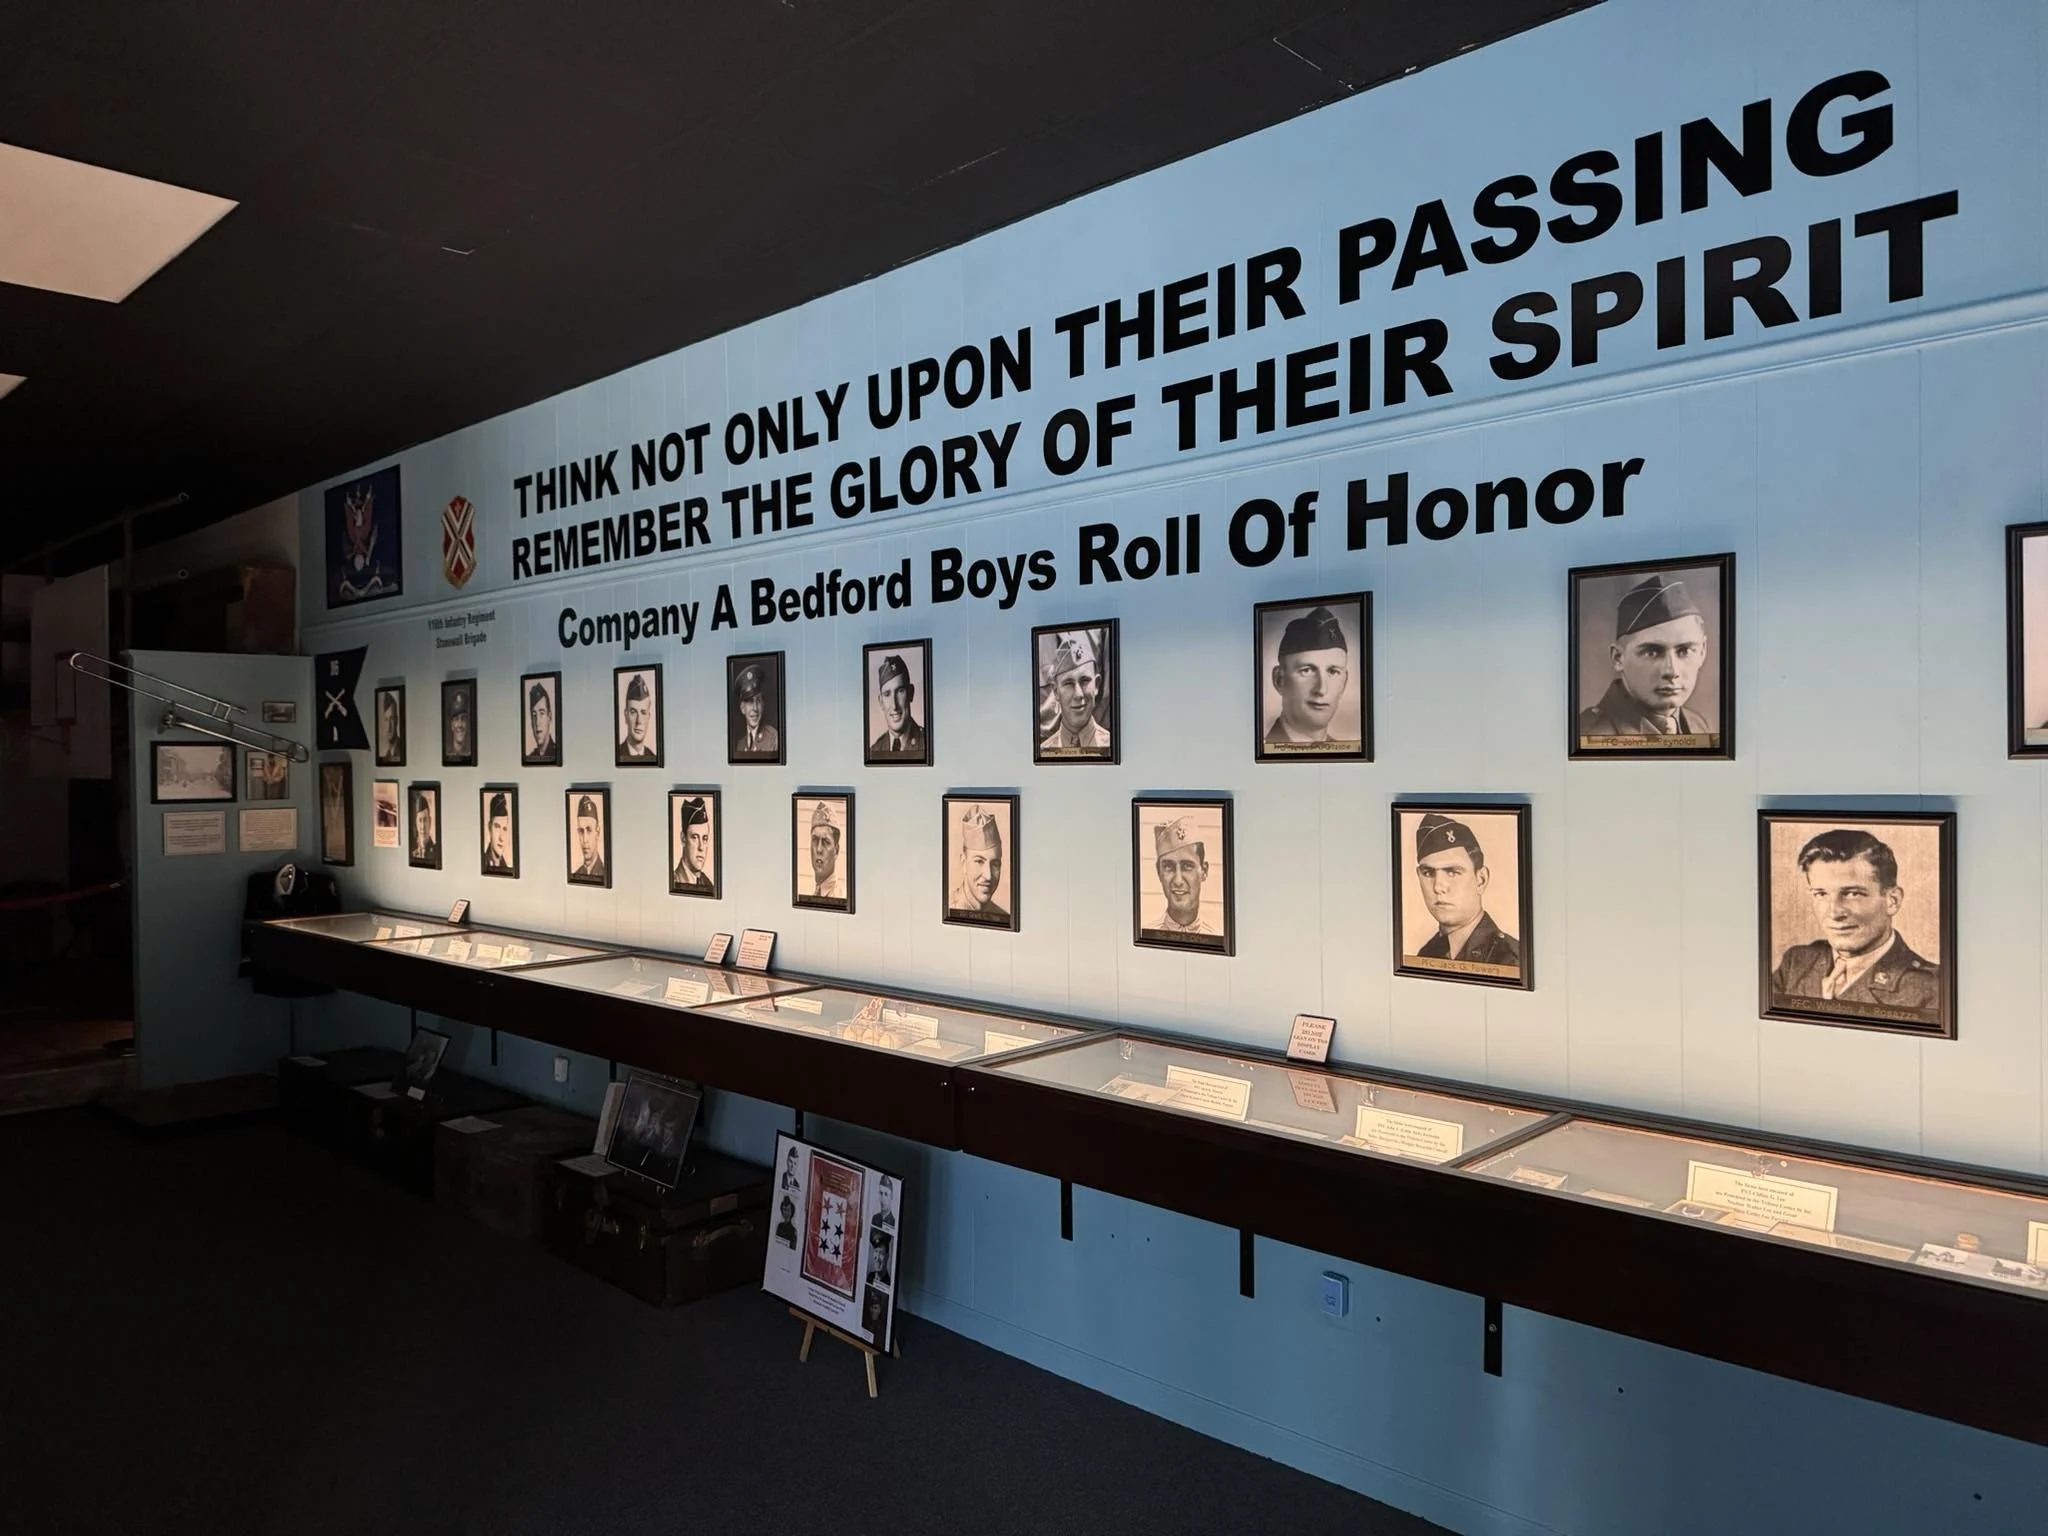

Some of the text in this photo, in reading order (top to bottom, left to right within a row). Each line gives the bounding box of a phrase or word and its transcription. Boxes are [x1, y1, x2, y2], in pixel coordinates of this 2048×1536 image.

[513, 71, 1894, 519] THINK NOT ONLY UPON THEIR PASSING
[513, 190, 1959, 581] REMEMBER THE GLORY OF THEIR SPIRIT
[444, 615, 466, 629] Infantry
[467, 609, 496, 627] Regiment
[464, 631, 487, 647] Brigade
[559, 458, 1646, 651] Company A Bedford Boys Roll Of Honor
